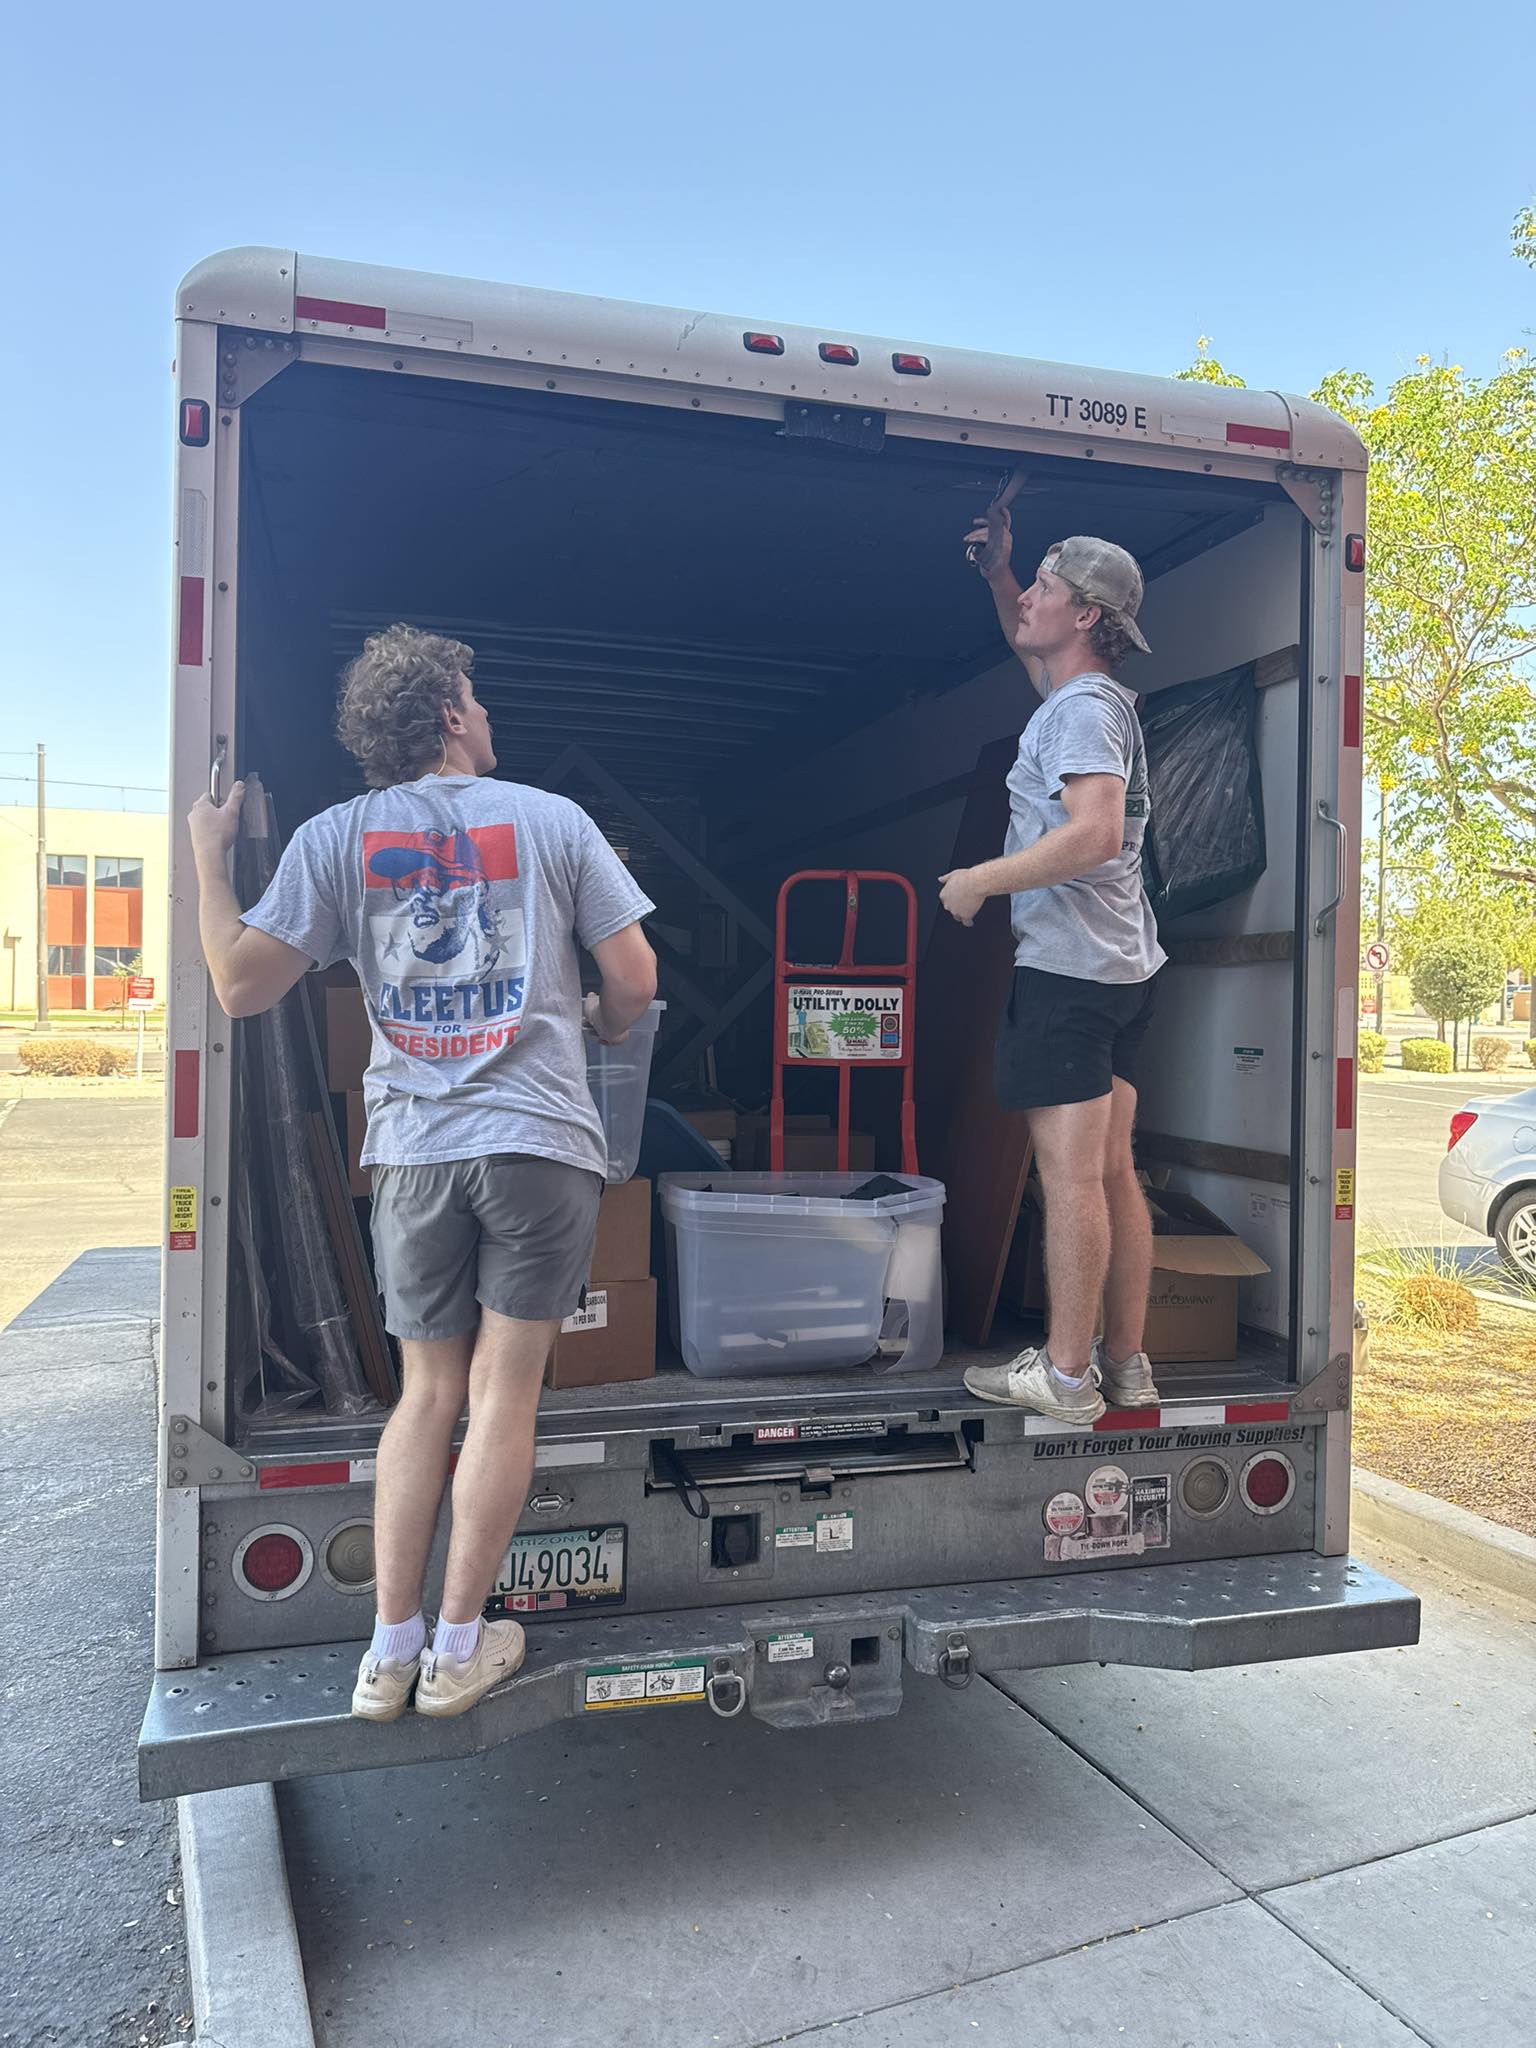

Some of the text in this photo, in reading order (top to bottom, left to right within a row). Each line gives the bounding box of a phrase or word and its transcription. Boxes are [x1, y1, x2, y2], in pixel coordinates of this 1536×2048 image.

[1046, 393, 1147, 429] TT 3089 E
[793, 997, 900, 1011] UTILITY DOLLY
[433, 1024, 462, 1034] FOR
[842, 1026, 866, 1034] 50%
[1170, 1294, 1216, 1305] COMPANY
[757, 1426, 795, 1439] DANGER
[1033, 1440, 1078, 1458] Don't
[1082, 1437, 1134, 1456] Forget
[1139, 1435, 1173, 1451] Your
[1176, 1430, 1232, 1448] Moving
[511, 1534, 588, 1547] ARIZONA
[492, 1545, 609, 1593] J49034
